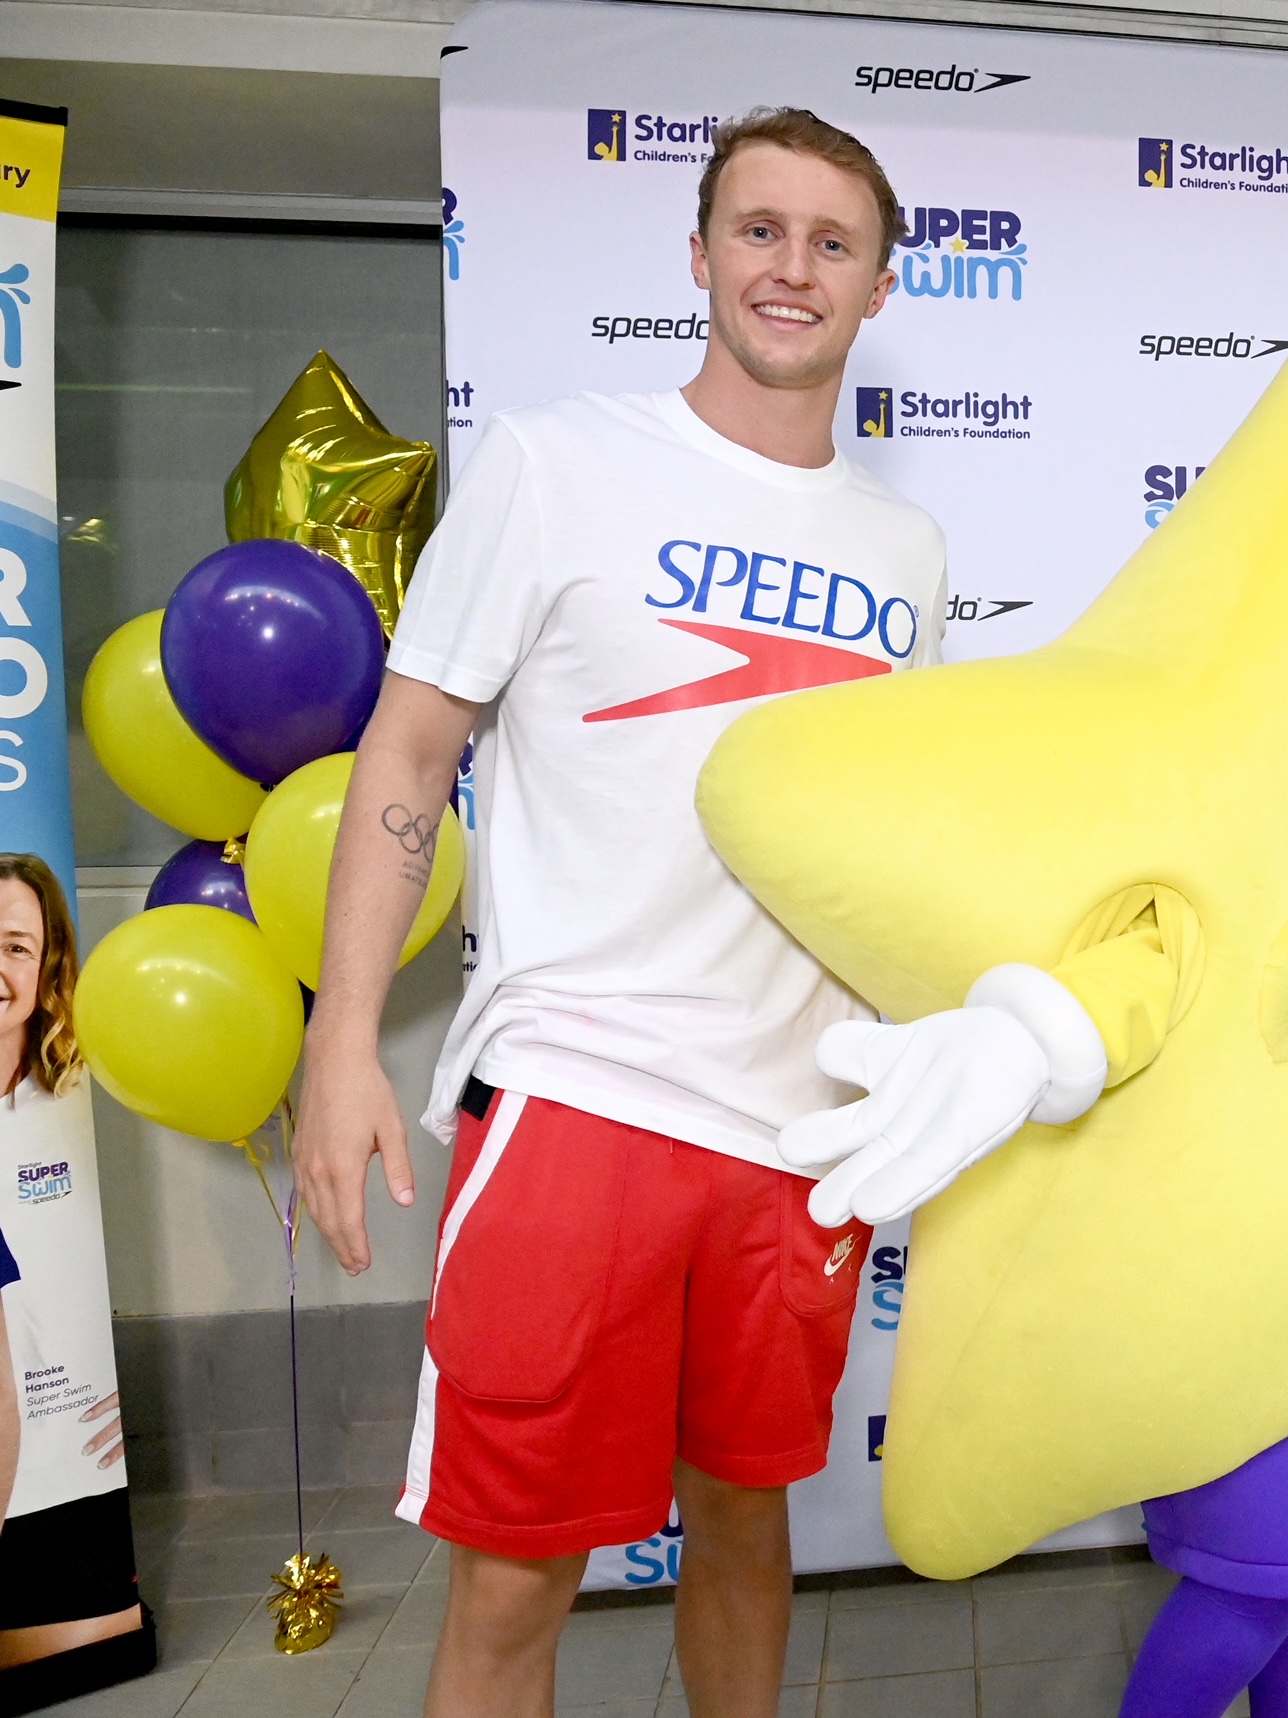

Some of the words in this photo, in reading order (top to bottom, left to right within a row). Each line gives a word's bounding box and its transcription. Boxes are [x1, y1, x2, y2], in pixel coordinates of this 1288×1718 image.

[855, 64, 975, 94] speedo
[635, 114, 719, 143] Starli
[634, 150, 697, 163] Children's
[1180, 177, 1236, 191] Children's
[897, 206, 1022, 251] UPER
[1139, 332, 1252, 362] speedo
[900, 391, 1033, 427] Starlight
[900, 426, 959, 438] Children's
[963, 428, 1031, 440] Foundation
[644, 540, 918, 659] SPEEDO
[18, 1161, 69, 1183] SUPER
[24, 1365, 65, 1381] Brooke
[25, 1377, 70, 1394] Hanson
[26, 1391, 61, 1407] Super
[63, 1384, 92, 1398] Swim
[26, 1394, 99, 1420] Ambassador
